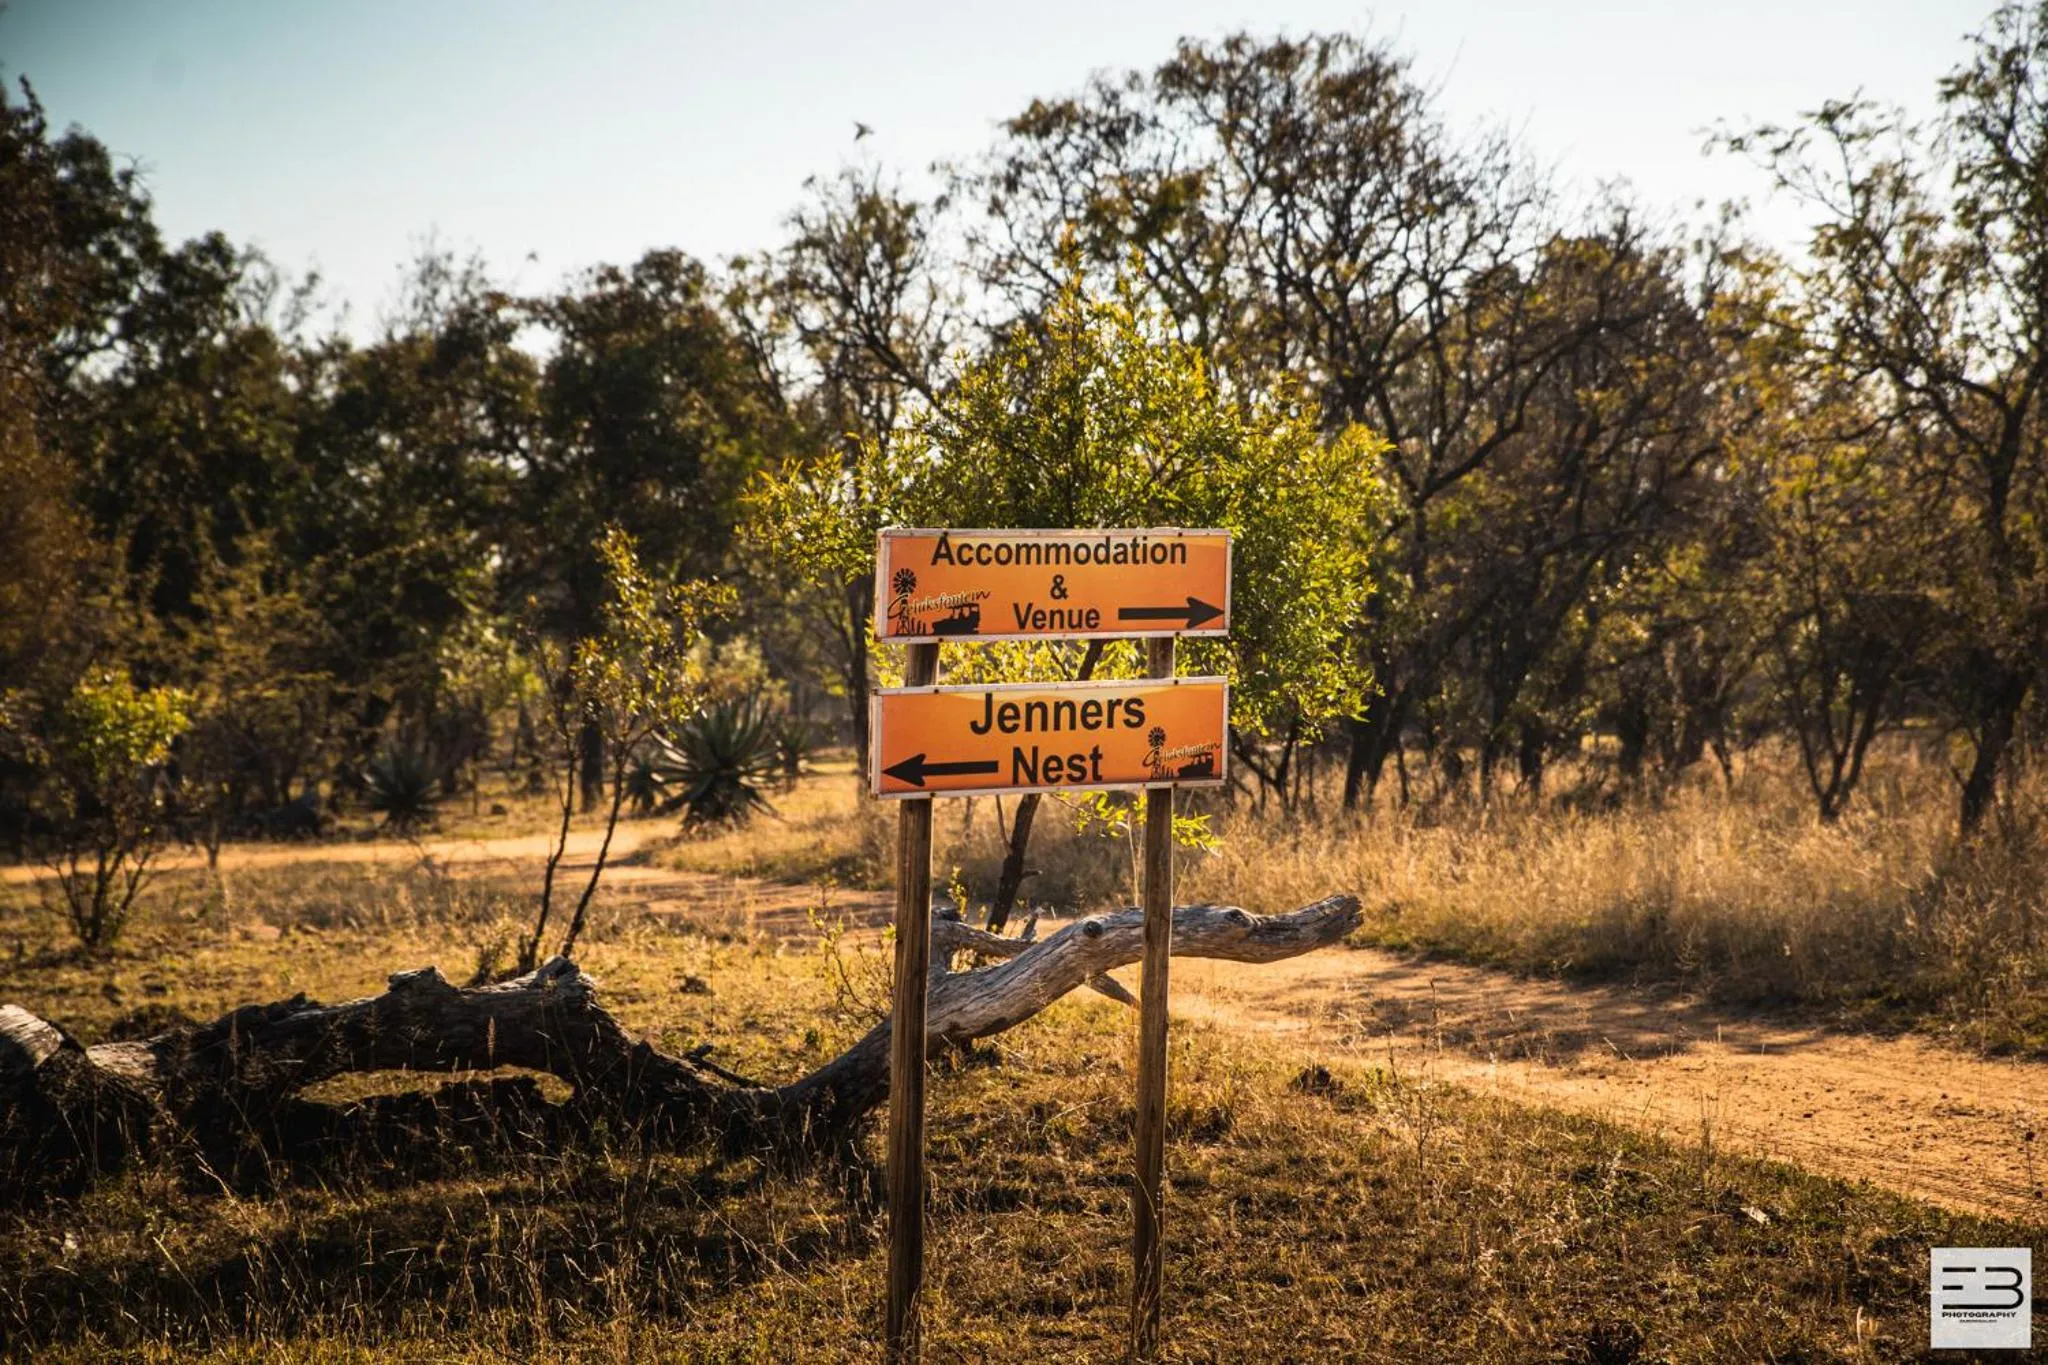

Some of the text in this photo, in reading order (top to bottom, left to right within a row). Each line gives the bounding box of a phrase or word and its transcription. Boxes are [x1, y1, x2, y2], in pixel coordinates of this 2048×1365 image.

[931, 535, 1187, 566] Accommodation
[1050, 574, 1068, 600] &
[1013, 603, 1100, 630] Venue
[969, 692, 1146, 735] Jenners
[1012, 745, 1104, 785] Nest
